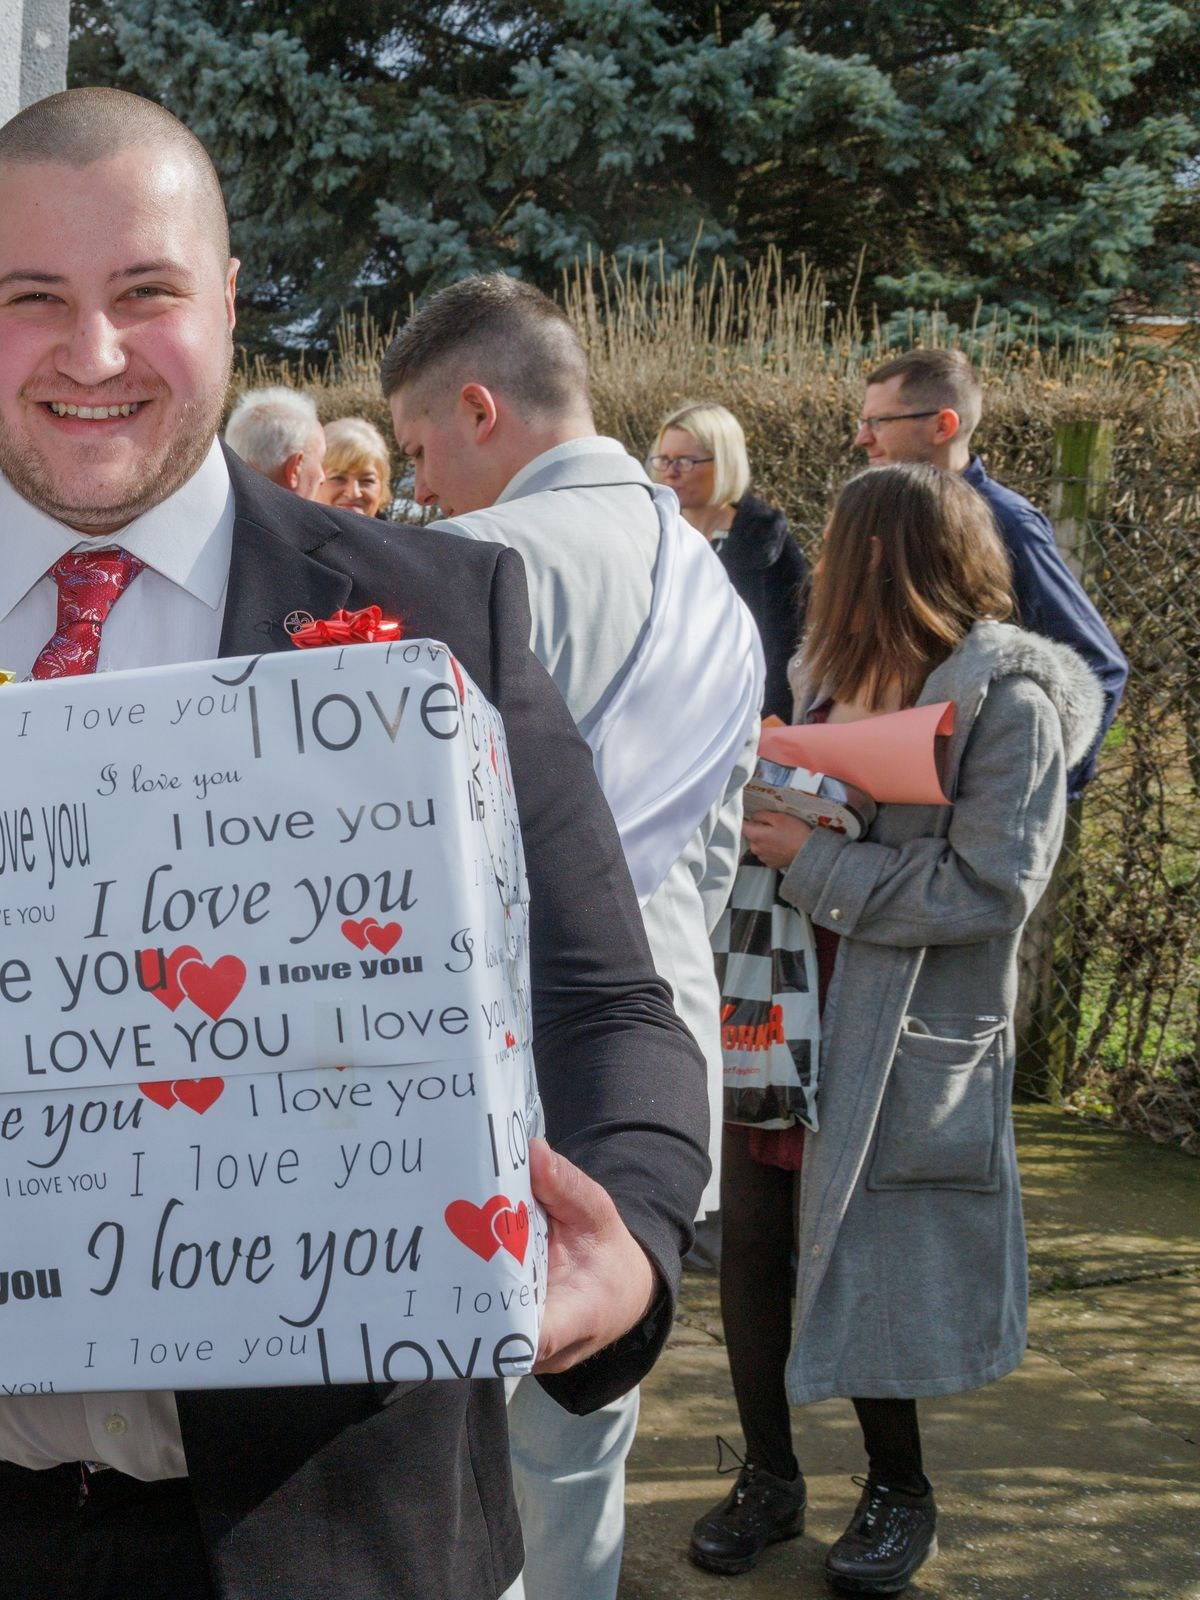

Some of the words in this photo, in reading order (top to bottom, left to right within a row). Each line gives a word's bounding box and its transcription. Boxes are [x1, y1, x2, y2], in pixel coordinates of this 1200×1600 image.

[333, 648, 345, 671] I
[382, 644, 440, 665] lov
[17, 710, 32, 738] I
[64, 703, 146, 732] love
[169, 692, 239, 725] you
[247, 685, 262, 759] I
[291, 679, 458, 754] love
[96, 763, 118, 797] I
[131, 763, 182, 793] love
[192, 770, 242, 800] you
[41, 801, 91, 891] you
[172, 813, 183, 851] I
[205, 809, 315, 848] love
[336, 798, 436, 844] you
[16, 904, 56, 925] YOU
[83, 879, 118, 940] I
[141, 863, 271, 935] love
[288, 868, 419, 945] you
[259, 964, 271, 986] I
[278, 961, 353, 985] love
[358, 955, 424, 980] you
[443, 927, 474, 974] I
[54, 947, 168, 1013] you
[24, 1023, 156, 1076] LOVE
[173, 1013, 290, 1063] YOU
[335, 1007, 345, 1044] I
[361, 1004, 470, 1042] love
[249, 1083, 259, 1117] I
[277, 1072, 374, 1116] love
[386, 1071, 476, 1117] you
[26, 1097, 145, 1169] you
[487, 1113, 500, 1178] I
[507, 1109, 527, 1170] LO
[5, 1177, 11, 1198] I
[18, 1175, 63, 1197] LOVE
[67, 1172, 107, 1192] YOU
[129, 1151, 146, 1198] I
[189, 1144, 300, 1192] love
[333, 1137, 423, 1190] you
[87, 1221, 125, 1297] I
[151, 1197, 275, 1291] love
[278, 1225, 424, 1329] you
[403, 1289, 417, 1318] I
[452, 1285, 530, 1315] love
[84, 1341, 97, 1369] I
[129, 1337, 214, 1365] love
[238, 1334, 307, 1364] you
[317, 1328, 331, 1384] I
[360, 1322, 534, 1381] love
[1, 1380, 55, 1396] you
